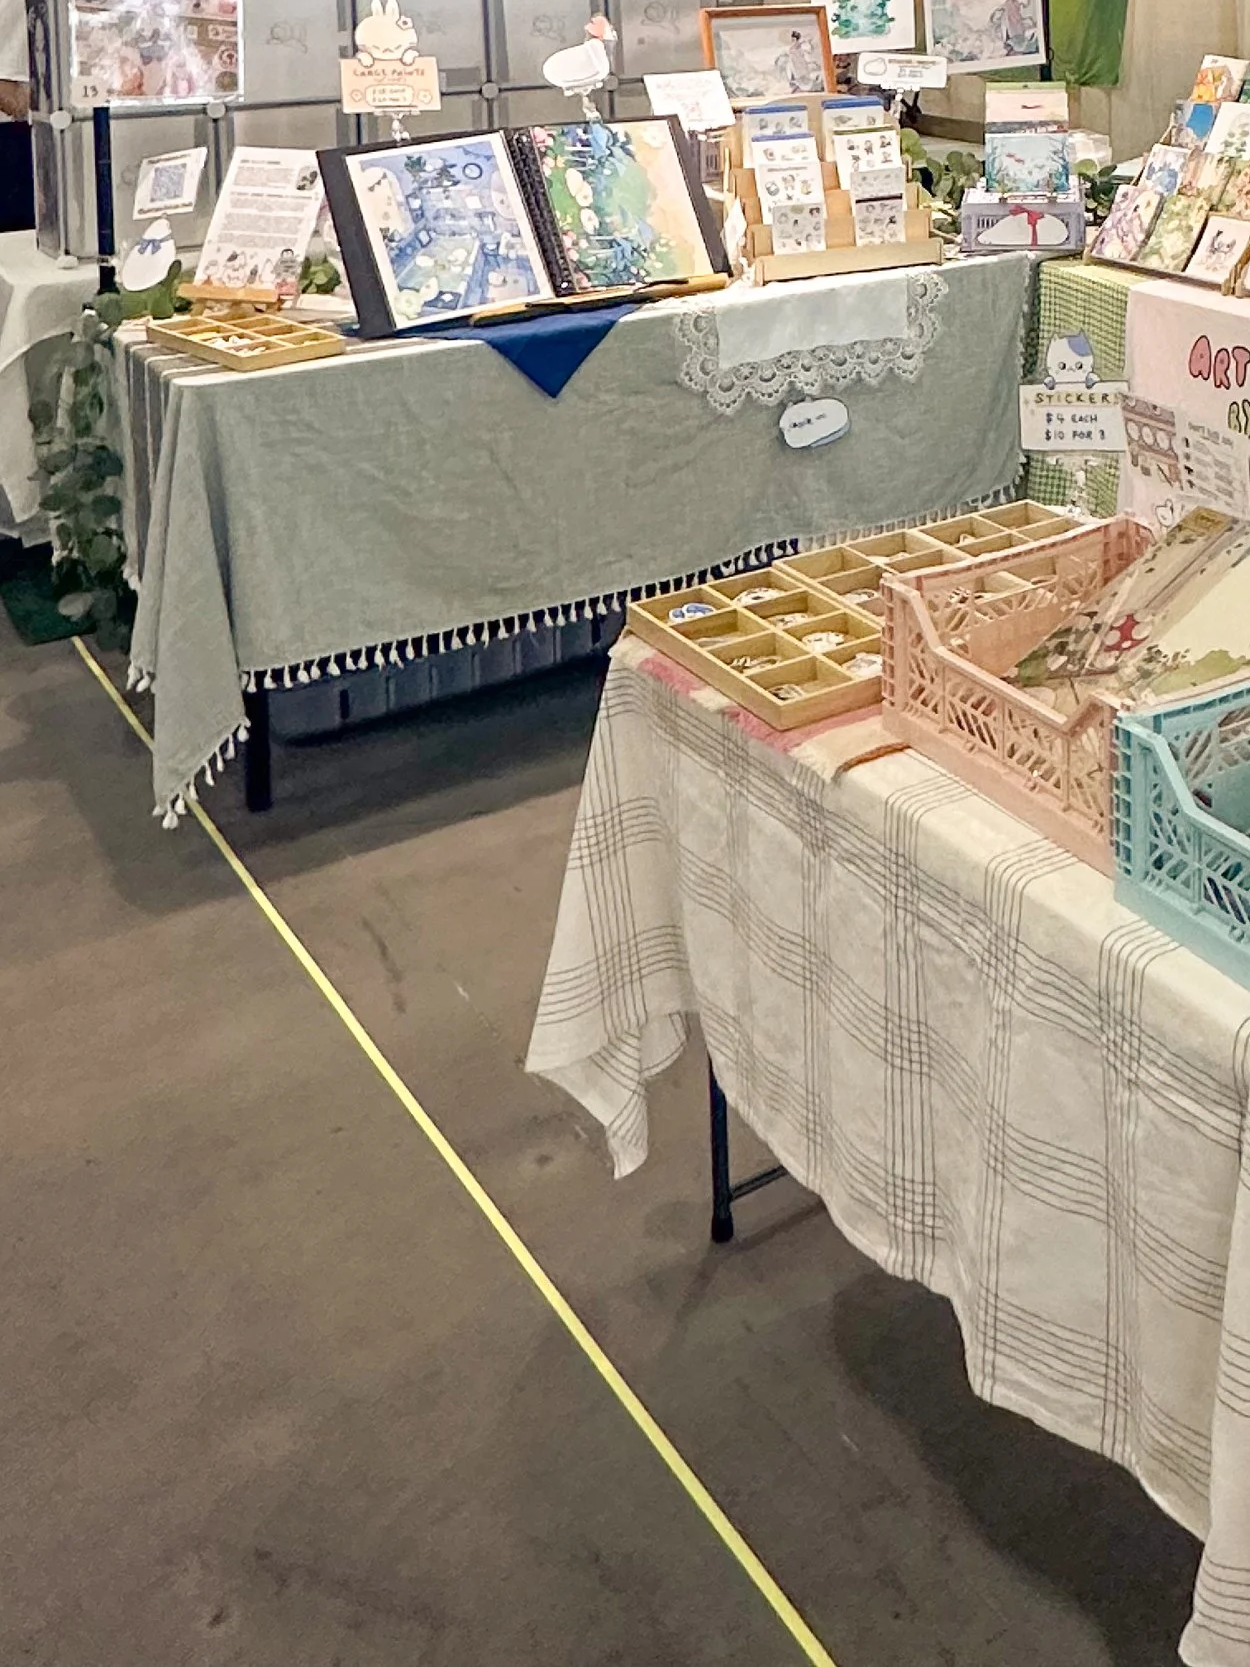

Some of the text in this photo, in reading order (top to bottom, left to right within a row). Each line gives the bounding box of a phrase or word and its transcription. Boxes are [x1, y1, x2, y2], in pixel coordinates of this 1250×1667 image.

[82, 85, 99, 99] 13
[1071, 413, 1098, 424] EACH
[1044, 428, 1106, 442] $10 FOR 3
